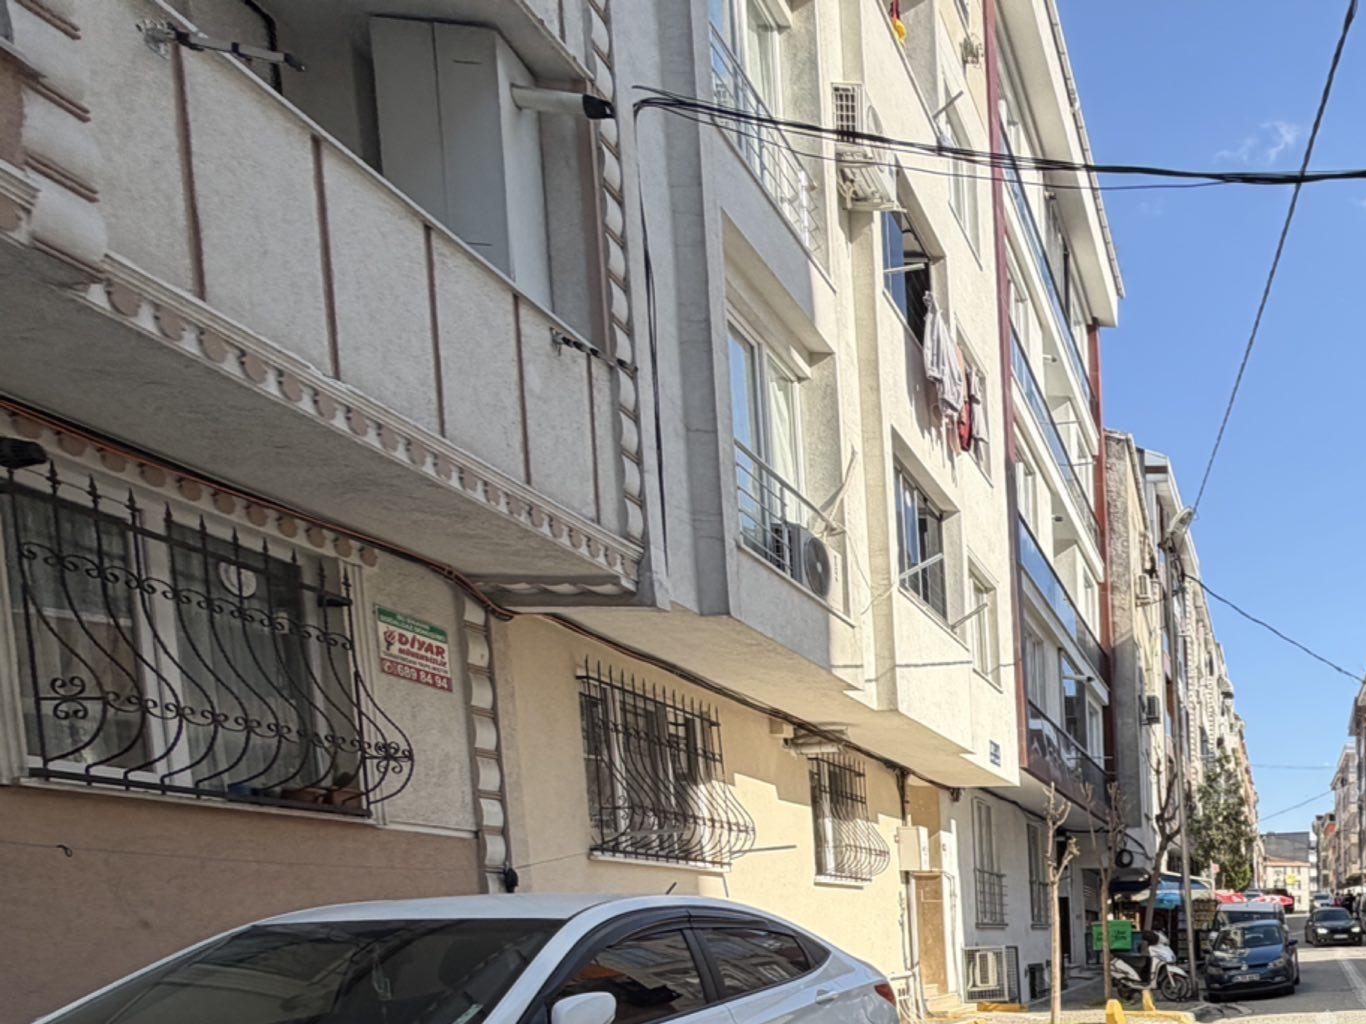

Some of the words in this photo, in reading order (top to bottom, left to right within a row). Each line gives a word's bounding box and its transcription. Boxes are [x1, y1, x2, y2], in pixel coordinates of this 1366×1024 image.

[398, 633, 445, 659] DİYAR
[419, 670, 434, 685] 84
[434, 675, 449, 690] 94
